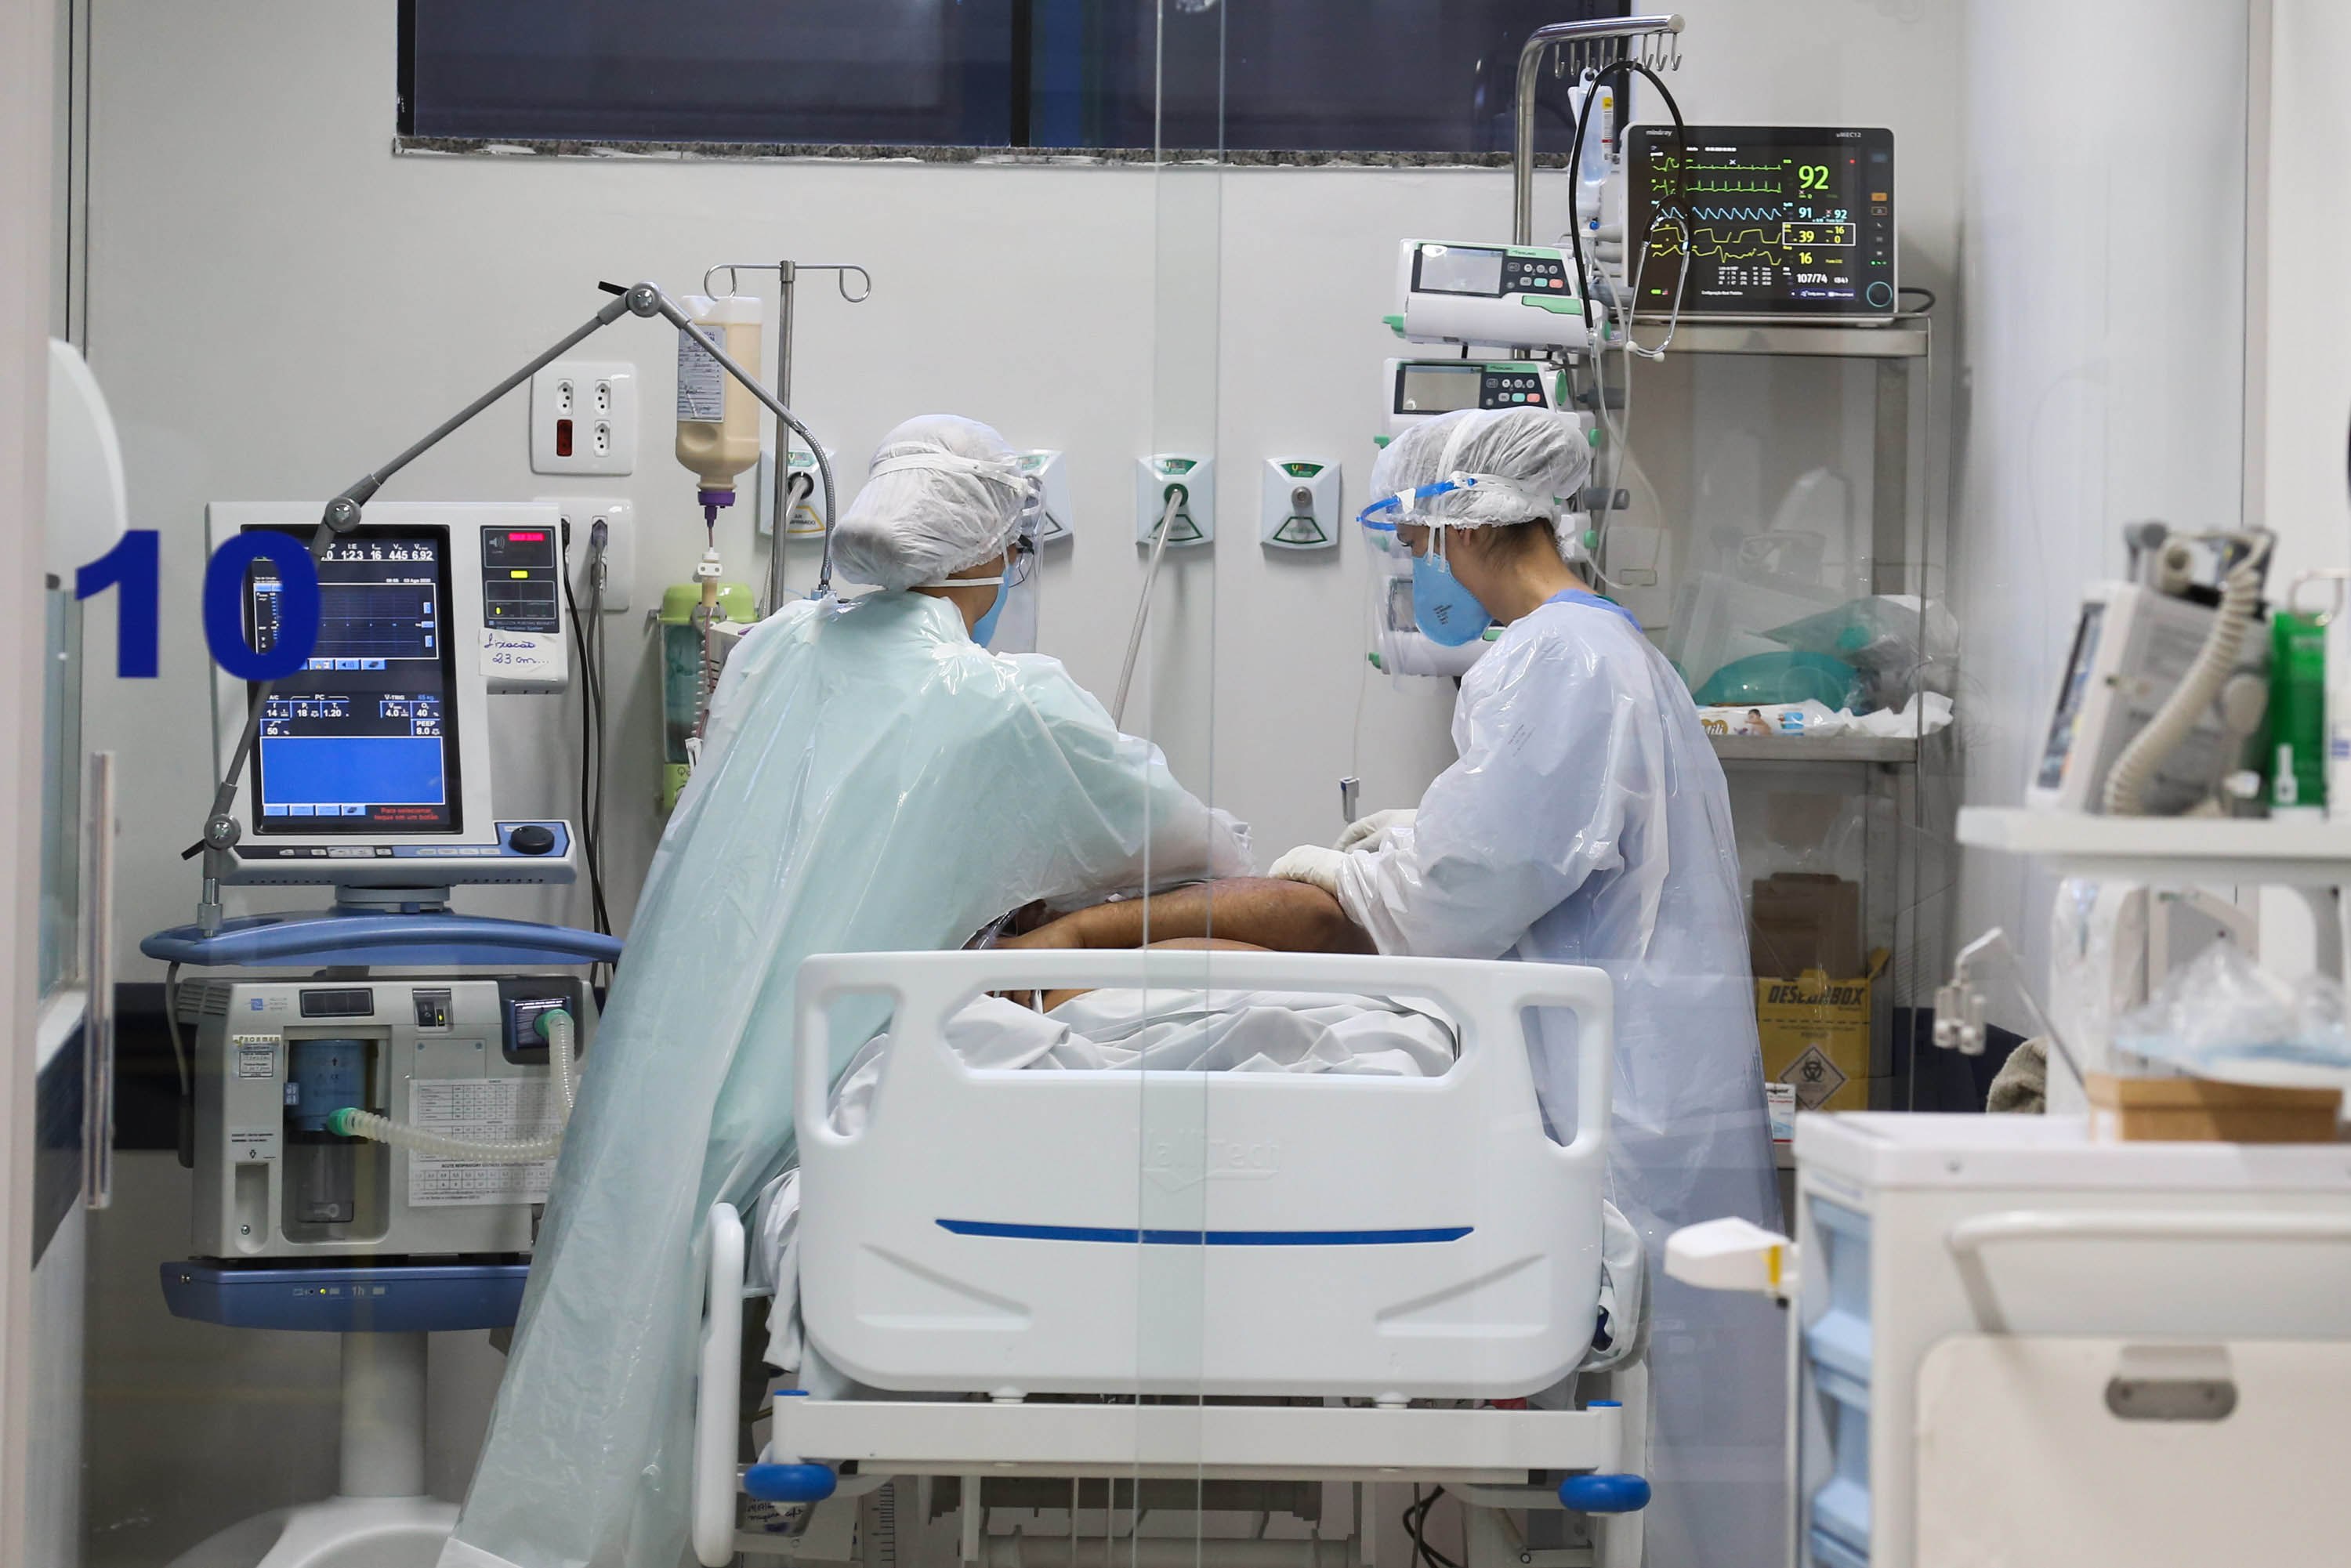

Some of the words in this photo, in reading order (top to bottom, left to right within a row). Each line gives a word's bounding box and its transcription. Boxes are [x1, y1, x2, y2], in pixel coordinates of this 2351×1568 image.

[1799, 165, 1830, 190] 92
[1799, 207, 1813, 219] 91
[1834, 209, 1848, 219] 92
[1835, 226, 1845, 234] 16
[1799, 230, 1815, 243] 39
[1799, 252, 1813, 264] 16
[1796, 273, 1828, 283] 107/74
[370, 550, 382, 560] 16
[389, 550, 408, 560] 445
[411, 550, 433, 560] 6.92
[74, 529, 320, 682] 10
[492, 652, 512, 664] 23
[416, 726, 430, 735] 8.0
[1768, 984, 1864, 1005] DESARBOX
